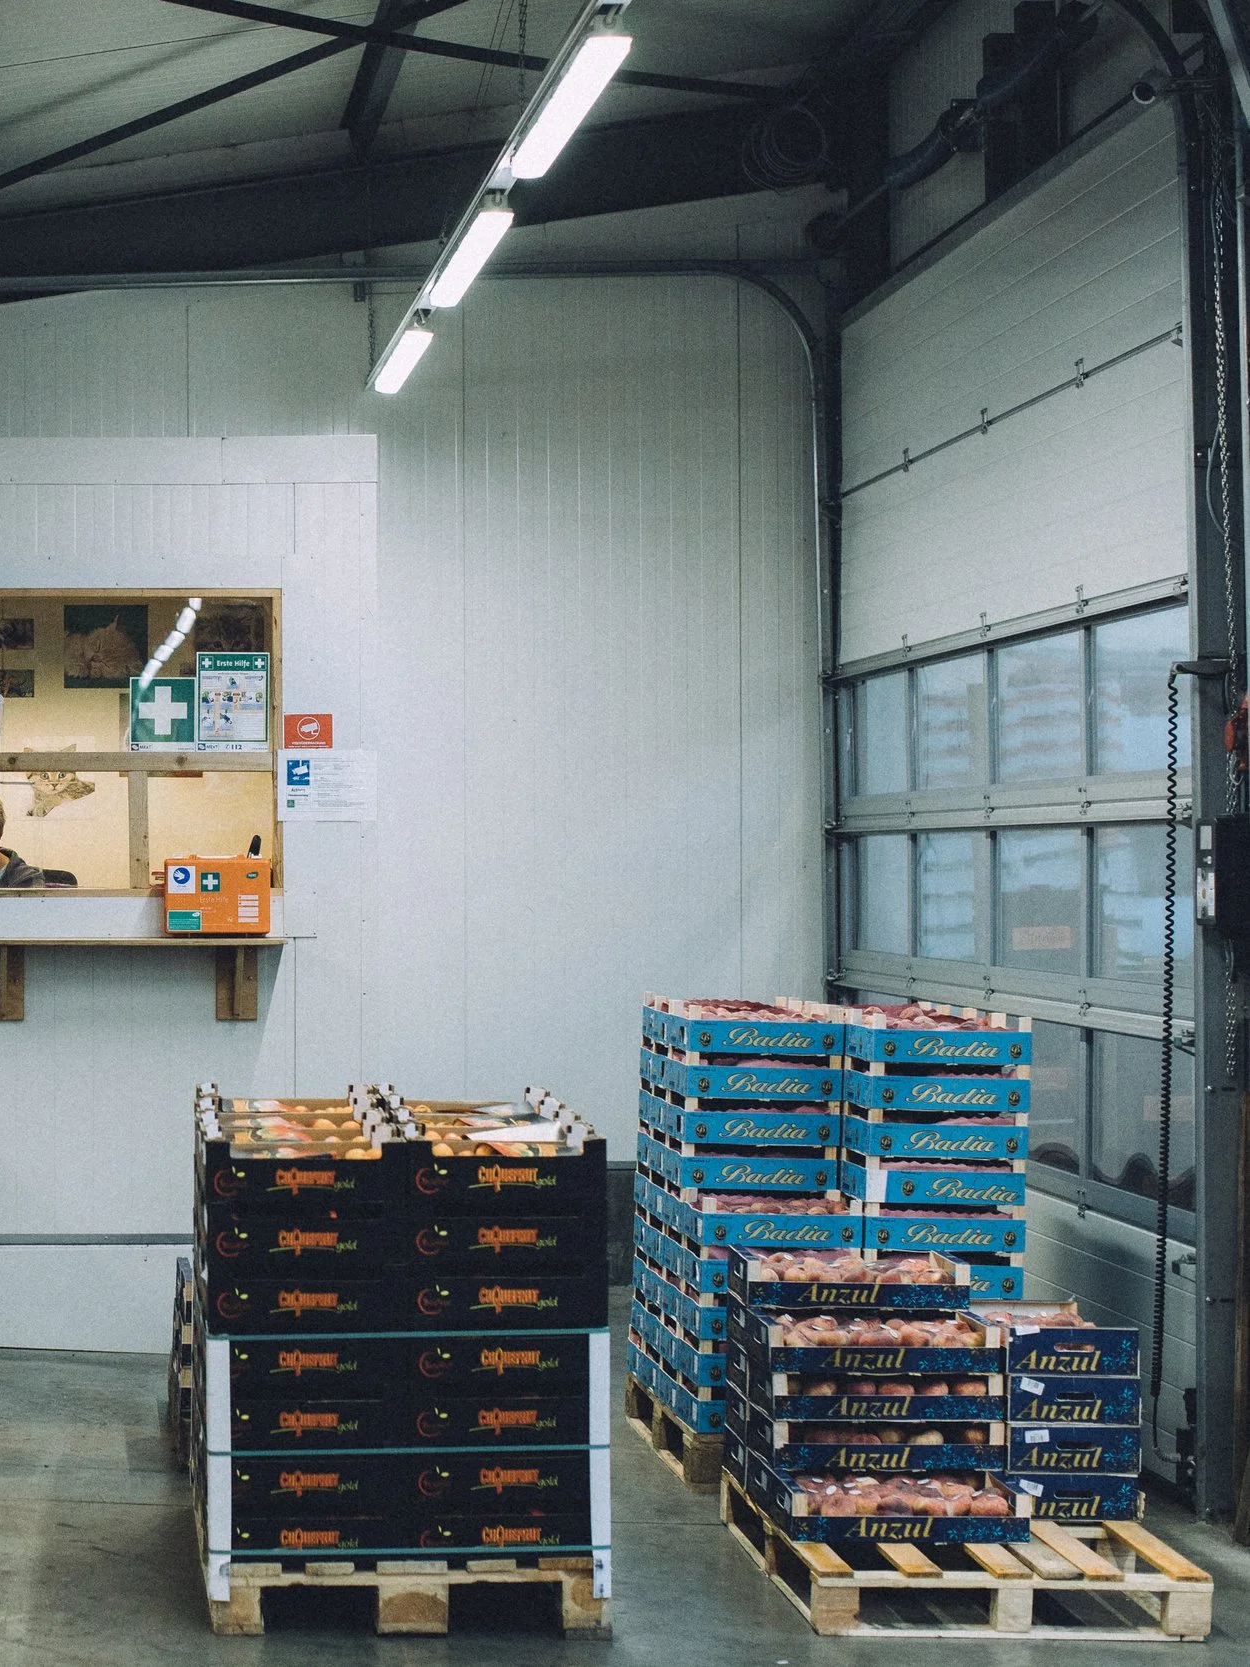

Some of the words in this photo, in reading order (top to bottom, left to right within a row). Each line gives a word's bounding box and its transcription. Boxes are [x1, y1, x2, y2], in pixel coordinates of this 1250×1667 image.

[234, 659, 250, 668] Hilfe
[723, 1026, 813, 1048] Badia
[908, 1036, 1000, 1058] Badia
[721, 1072, 811, 1094] Badia
[905, 1083, 999, 1105] Badia
[718, 1118, 807, 1139] Badia
[904, 1130, 997, 1152] Badia
[716, 1164, 805, 1184] Badia
[925, 1178, 1018, 1203] Badia
[738, 1220, 832, 1241] Badia
[902, 1223, 995, 1245] Badia
[797, 1283, 880, 1304] Anzul
[821, 1347, 905, 1370] Anzul
[1015, 1350, 1102, 1372] Anzul
[827, 1396, 911, 1418] Anzul
[1016, 1399, 1102, 1422] Anzul
[826, 1447, 911, 1470] Anzul
[1017, 1446, 1102, 1469] Anzul
[845, 1517, 934, 1540] Anzul
